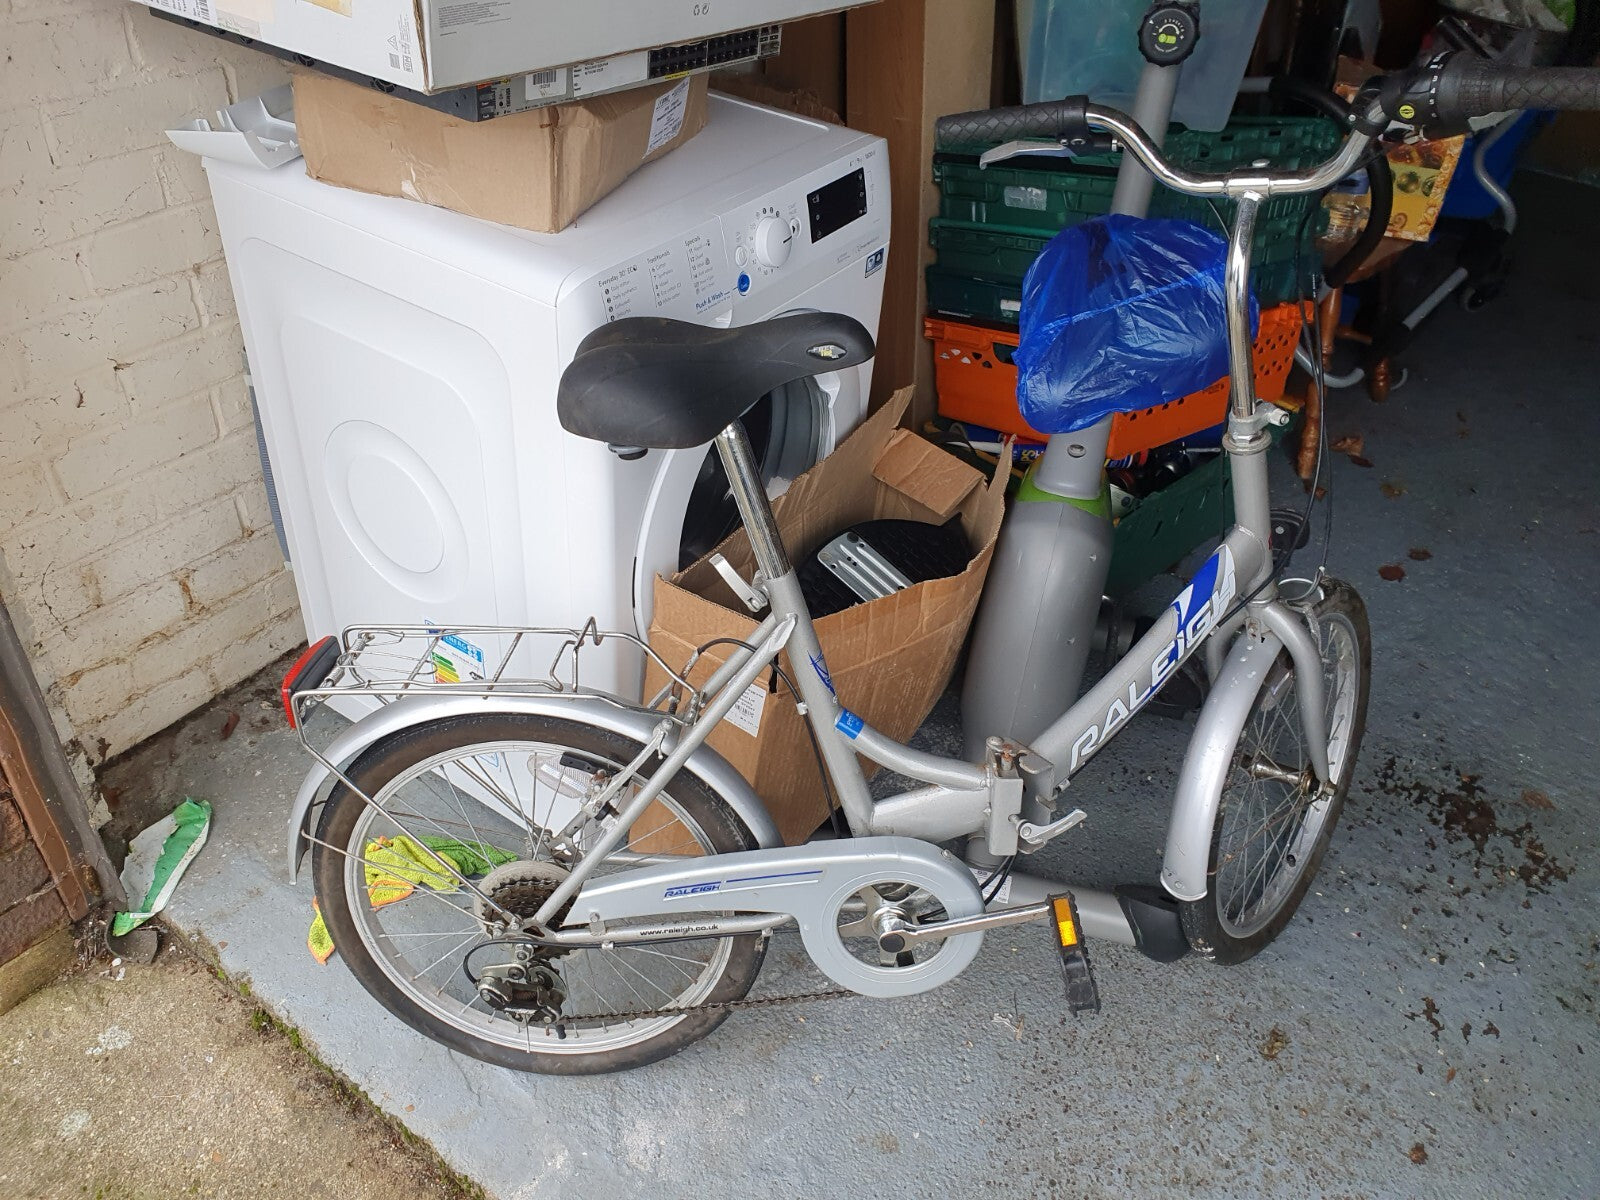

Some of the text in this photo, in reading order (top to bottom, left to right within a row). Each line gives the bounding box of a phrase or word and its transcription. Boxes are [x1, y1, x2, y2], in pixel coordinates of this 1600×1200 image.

[1070, 568, 1236, 773] RALEIGH
[664, 883, 721, 898] RALEIGH
[639, 923, 719, 936] www.raleigh.co.uk
